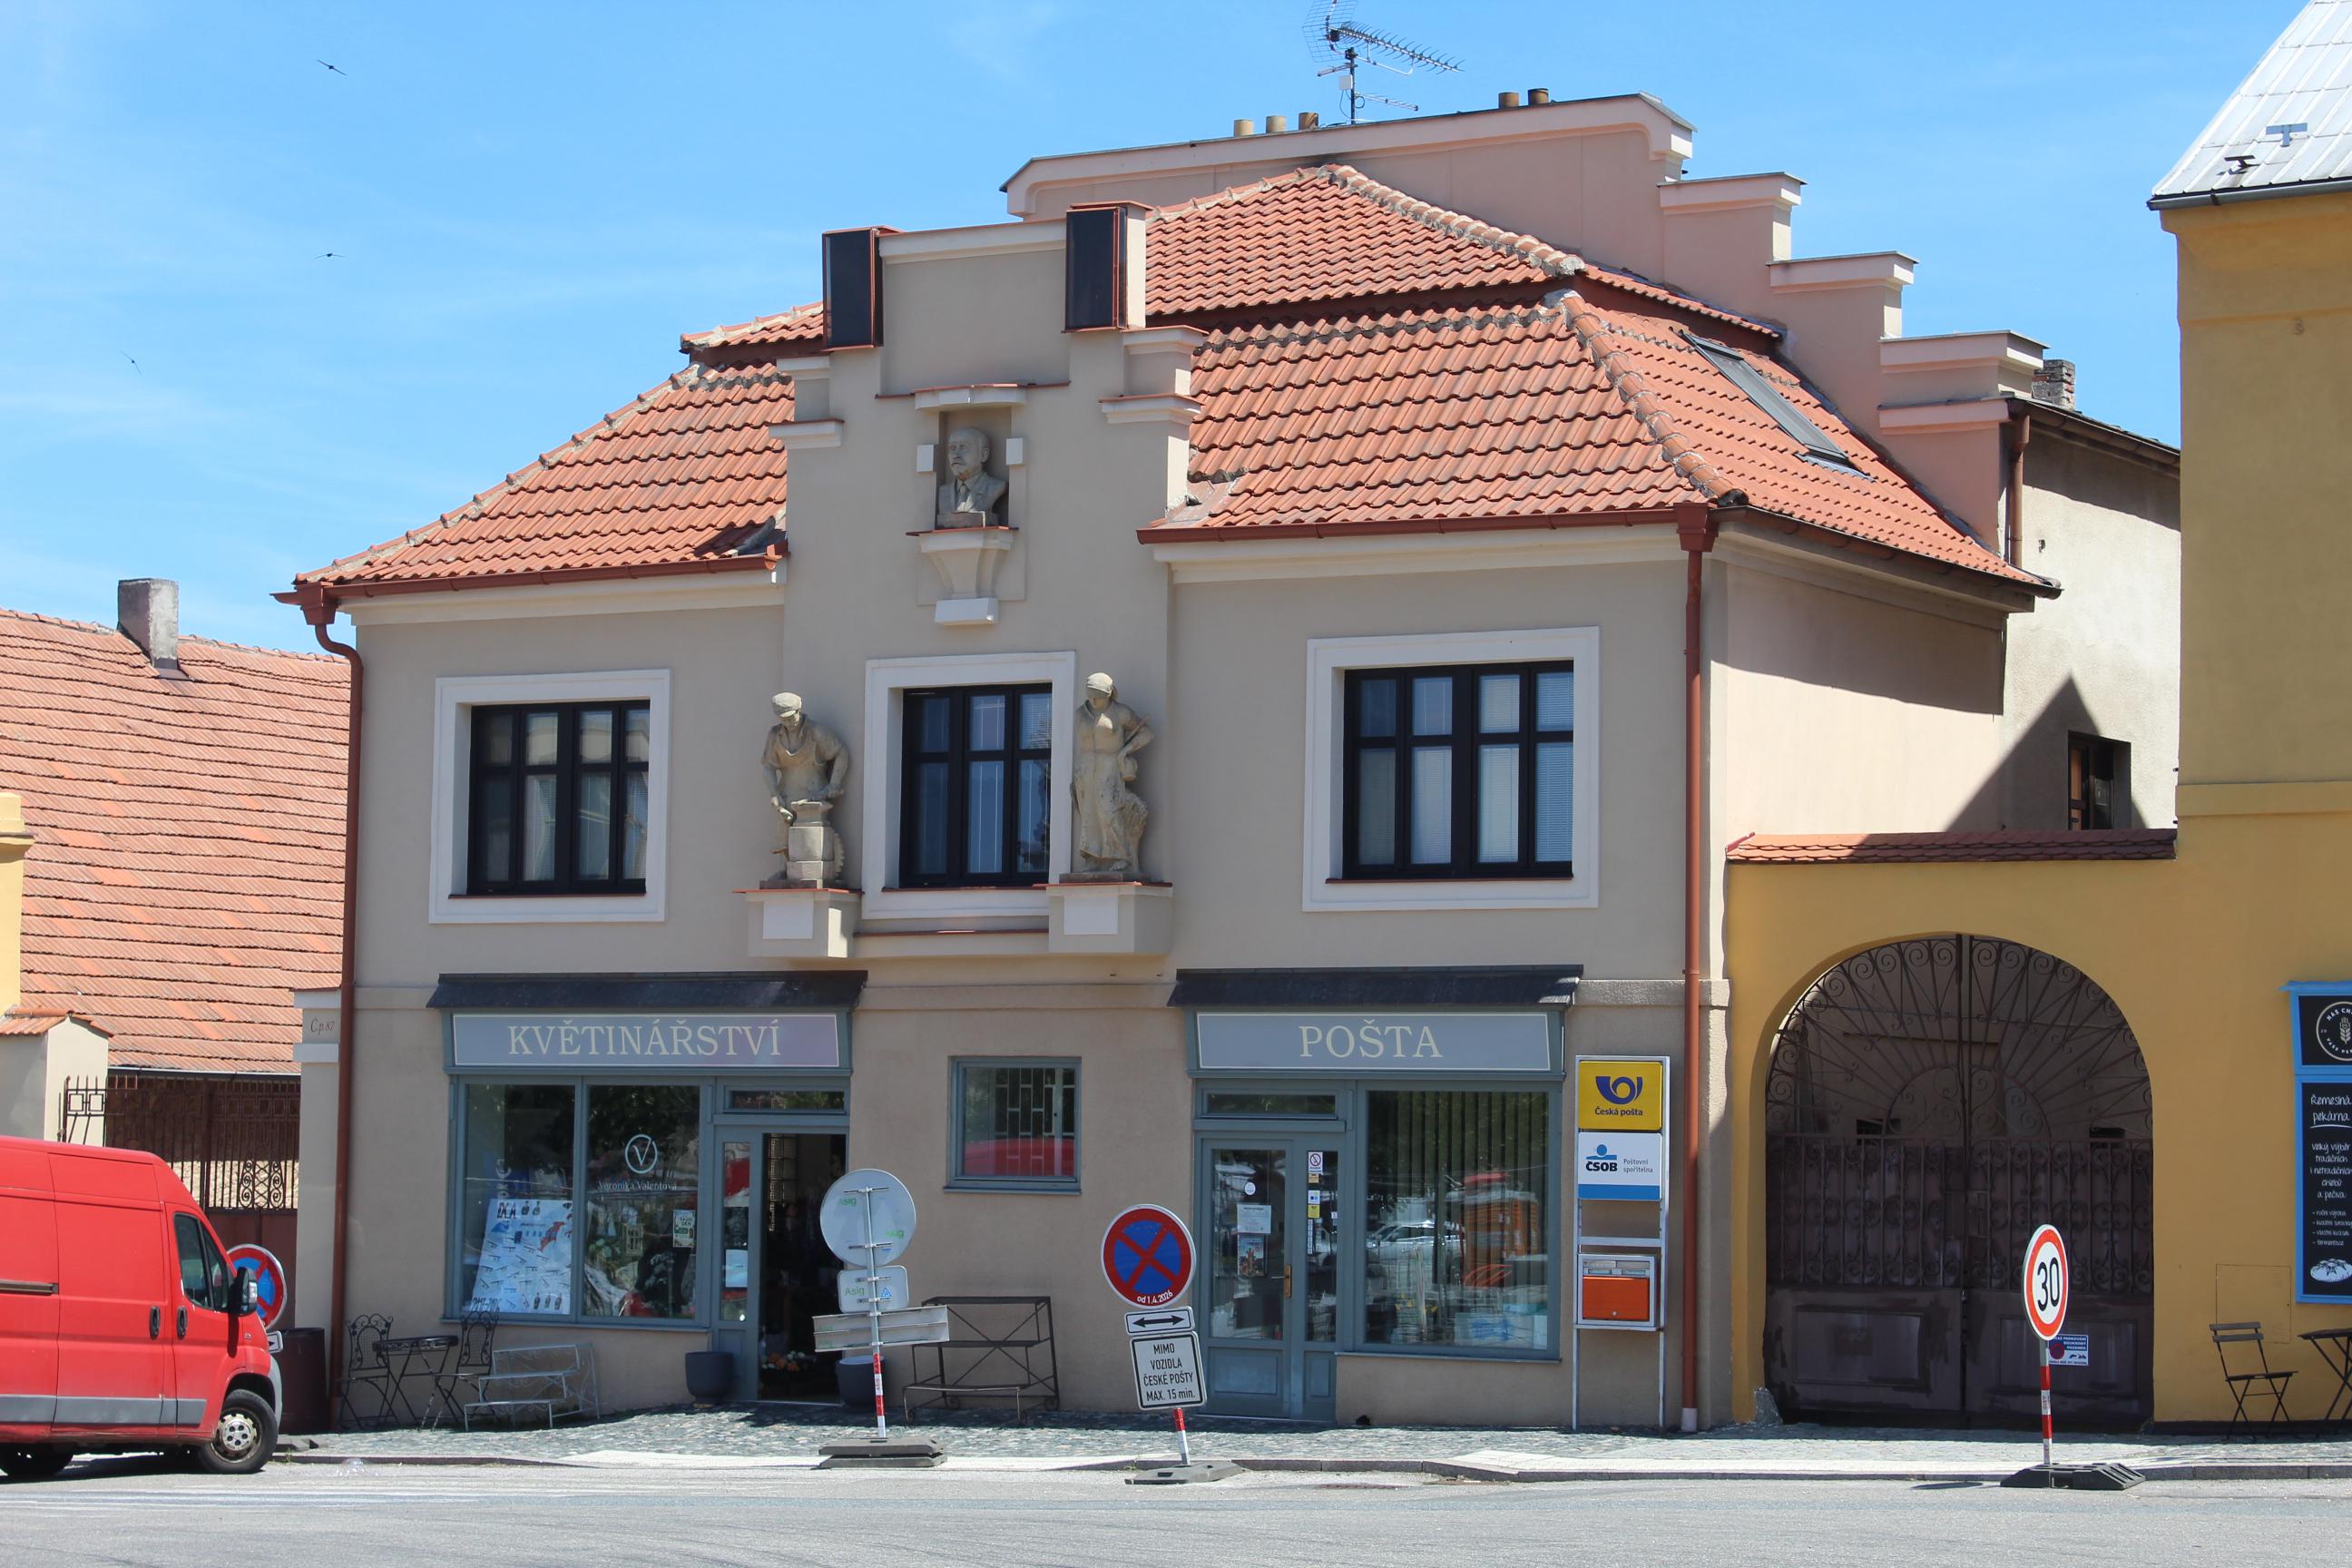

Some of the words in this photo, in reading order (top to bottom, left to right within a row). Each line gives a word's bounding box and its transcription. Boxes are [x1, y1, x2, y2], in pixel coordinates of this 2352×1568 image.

[507, 1019, 781, 1055] KVĚTINÁŘSTVÍ
[1298, 1018, 1444, 1058] POŠTA
[2310, 1093, 2352, 1105] Řemeslná
[1594, 1105, 1619, 1116] Česká
[1620, 1107, 1643, 1117] pošta
[2313, 1111, 2350, 1124] pekárna
[1585, 1161, 1618, 1172] ČSOB
[599, 1181, 635, 1191] Veronika
[636, 1181, 677, 1191] Valentová
[2324, 1191, 2346, 1201] pečiva
[2036, 1257, 2060, 1312] 30
[845, 1287, 865, 1297] Asig
[1136, 1296, 1147, 1304] od
[1153, 1343, 1175, 1355] MIMO
[1150, 1357, 1183, 1370] VOZIDLA
[1143, 1371, 1169, 1387] ČESKÉ
[1170, 1370, 1193, 1385] POŠTY
[1146, 1390, 1166, 1402] MAX.
[1167, 1389, 1177, 1400] 15
[1179, 1387, 1196, 1399] min.
